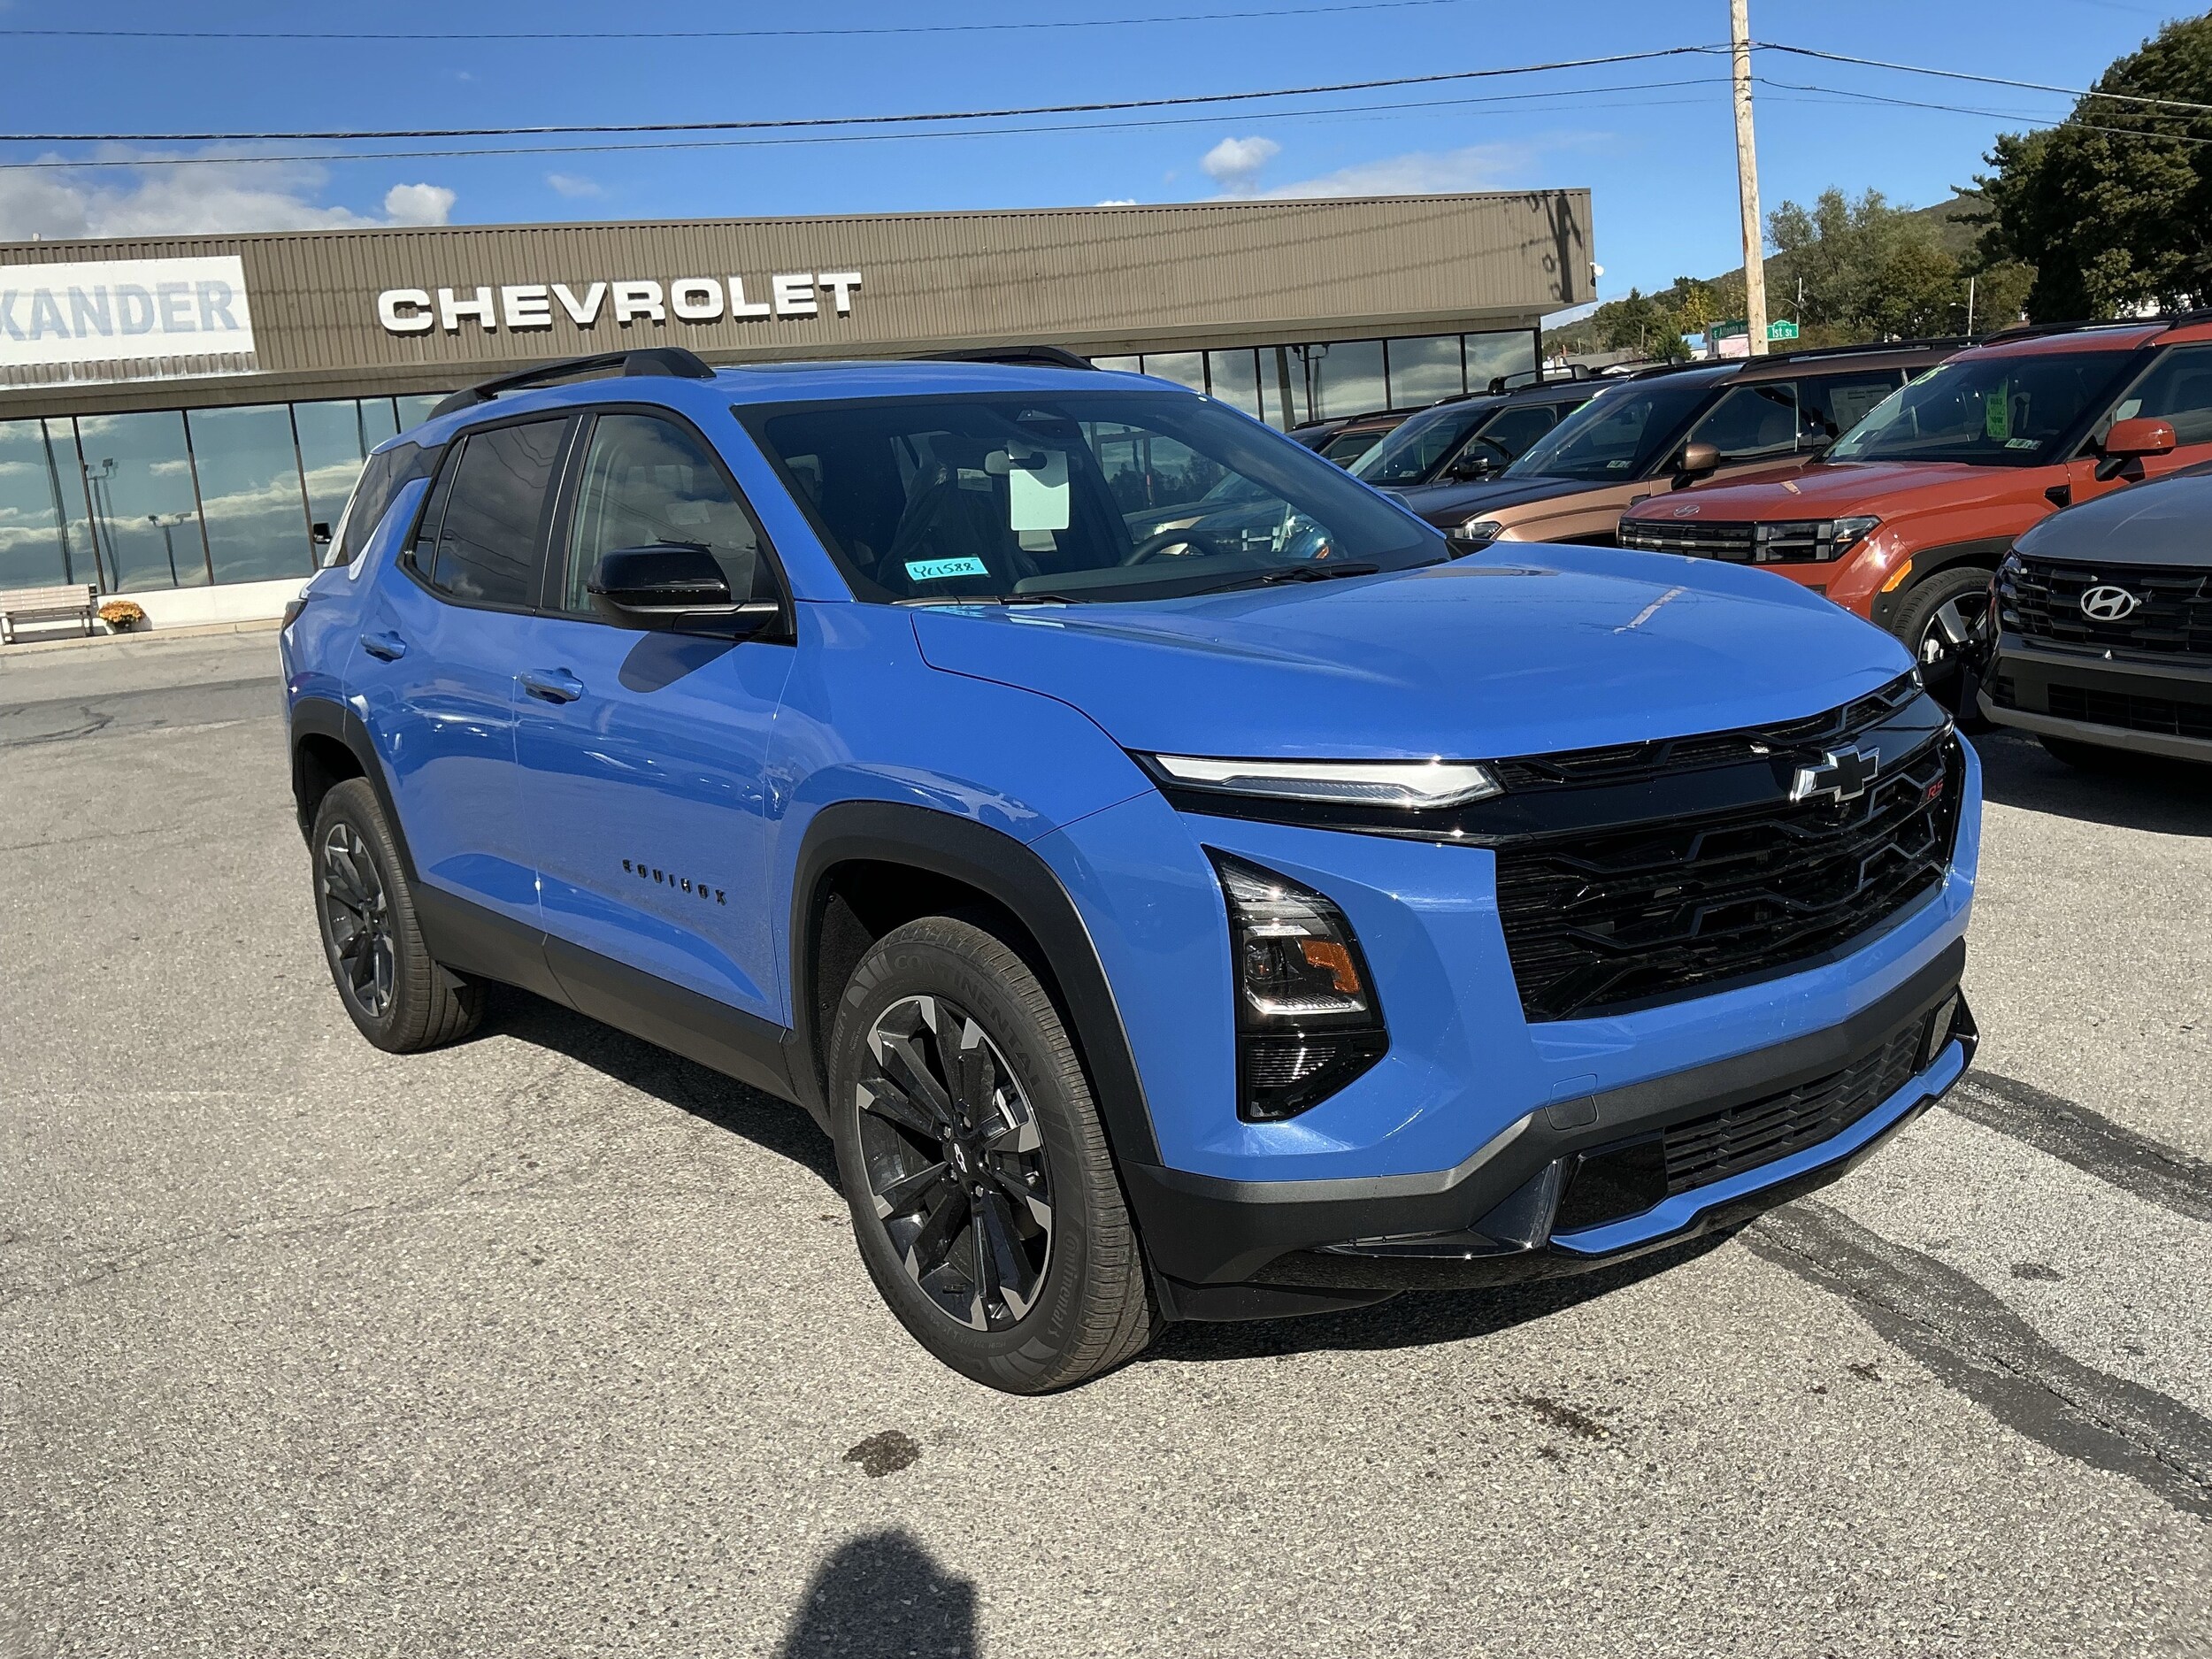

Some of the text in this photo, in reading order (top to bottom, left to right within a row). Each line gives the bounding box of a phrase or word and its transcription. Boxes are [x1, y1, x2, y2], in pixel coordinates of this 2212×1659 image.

[378, 272, 862, 332] CHEVROLET
[1771, 326, 1783, 338] 1st
[1927, 778, 1944, 801] RS
[622, 859, 726, 906] EQUINOX
